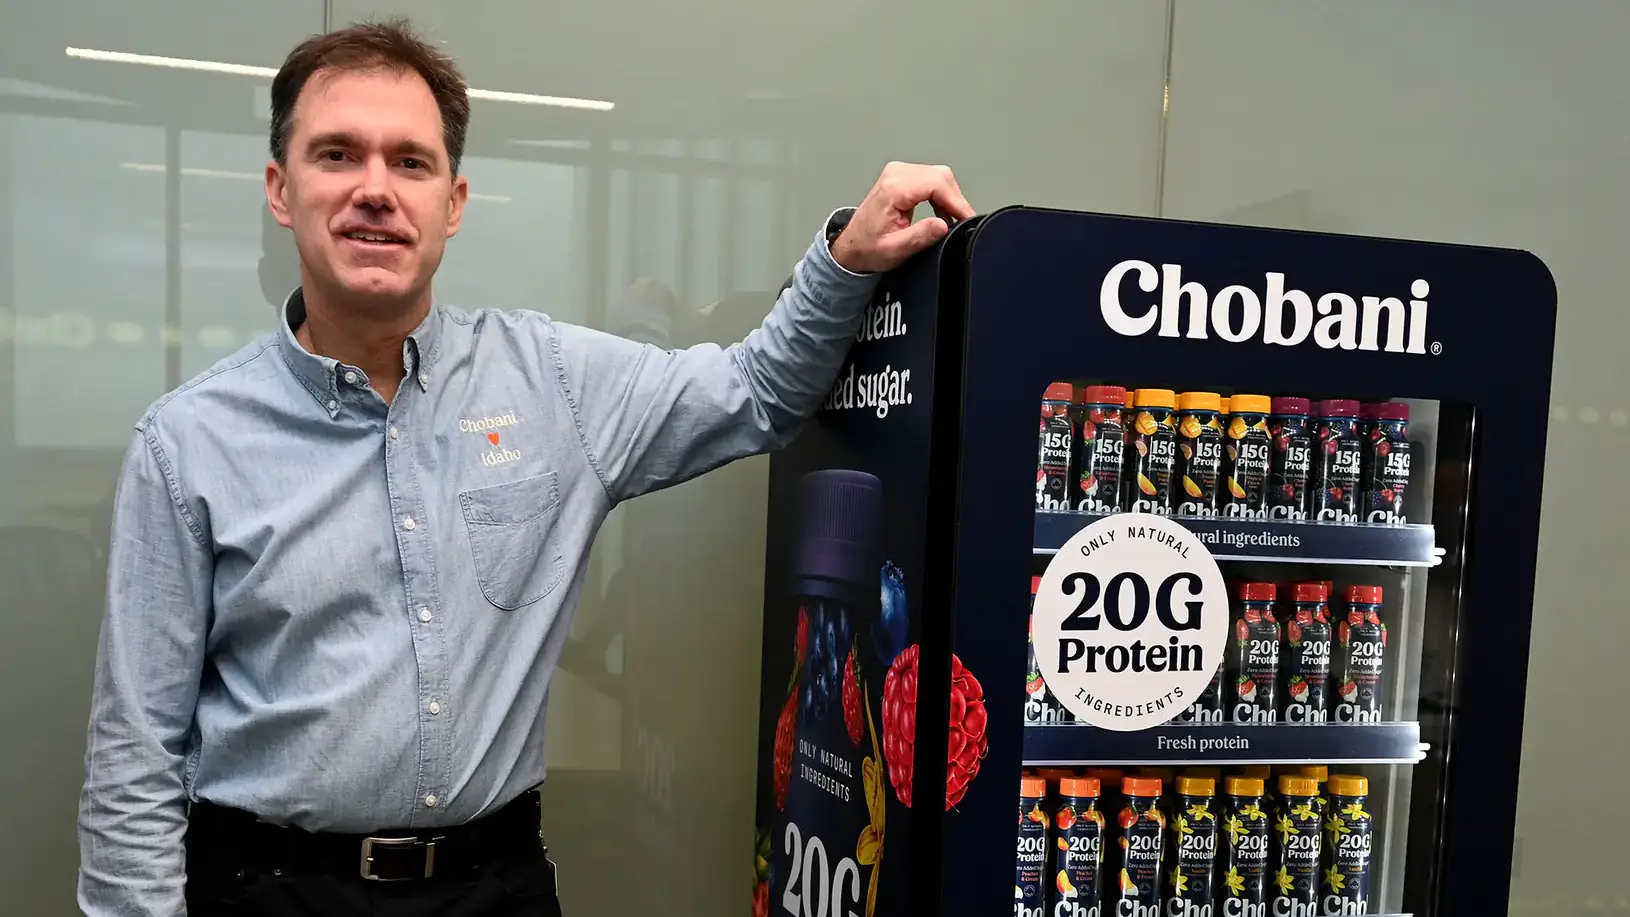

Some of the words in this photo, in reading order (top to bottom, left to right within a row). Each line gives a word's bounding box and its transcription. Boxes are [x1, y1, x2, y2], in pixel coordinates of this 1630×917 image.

[1100, 259, 1430, 355] Chobani
[857, 364, 913, 419] sugar.
[460, 411, 518, 432] Chobani
[1043, 447, 1072, 458] Prote
[1152, 440, 1175, 456] 15G
[1198, 442, 1221, 458] 15G
[1241, 444, 1268, 459] 15G
[481, 448, 521, 467] Idaho
[1094, 453, 1124, 463] Prote
[1150, 455, 1175, 465] Prot
[1193, 457, 1221, 466] Prot
[1336, 450, 1360, 465] 15G
[1387, 452, 1410, 467] 15G
[1285, 461, 1310, 470] Prot
[1332, 464, 1360, 474] Prot
[1384, 467, 1409, 476] Prot
[1080, 530, 1116, 557] ONLY
[1128, 527, 1190, 559] NATURAL
[1223, 530, 1301, 548] ingredients
[1061, 571, 1204, 631] 20G
[1057, 635, 1203, 673] Protein
[1250, 640, 1279, 654] 20G
[1302, 640, 1330, 655] 20G
[1352, 641, 1383, 656] 20G
[1249, 655, 1278, 664] Prote
[1301, 655, 1329, 665] Prot
[1351, 656, 1382, 666] Prot
[1074, 686, 1184, 717] INGREDIENTS
[1157, 735, 1197, 750] Fresh
[1199, 735, 1250, 752] protein
[800, 739, 817, 760] ONLY
[820, 748, 853, 778] NATURAL
[801, 763, 850, 802] INGREDIENTS
[1017, 837, 1045, 852] 20G
[1069, 836, 1100, 851] 20G
[1131, 835, 1161, 850] 20G
[1182, 835, 1214, 850] 20G
[1239, 835, 1268, 849] 20G
[1289, 834, 1319, 849] 20G
[1340, 834, 1370, 849] 20G
[1238, 850, 1267, 859] Prote
[1288, 850, 1319, 859] Prote
[1339, 849, 1370, 858] Prot
[782, 821, 861, 917] 20G
